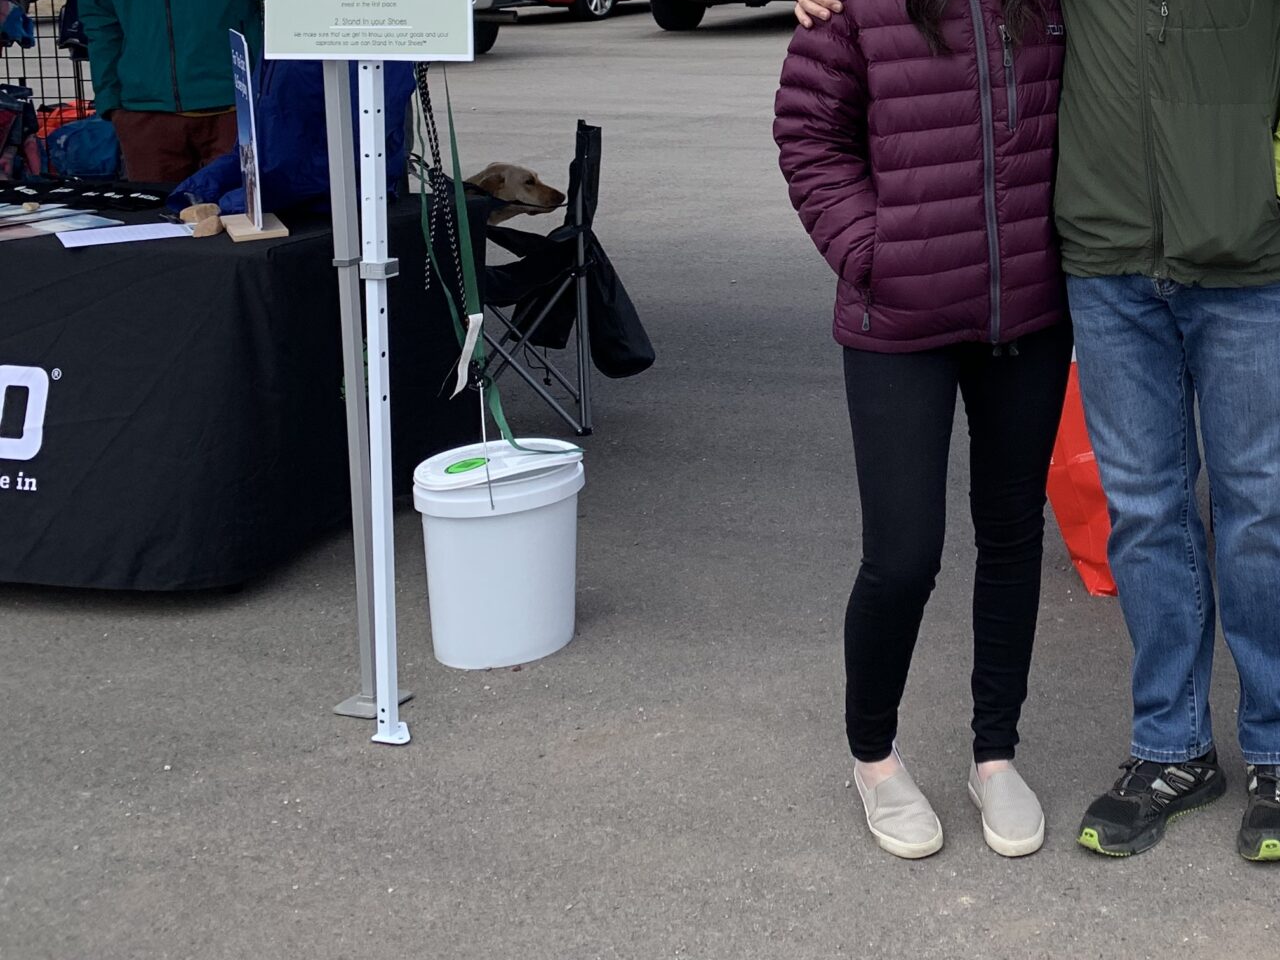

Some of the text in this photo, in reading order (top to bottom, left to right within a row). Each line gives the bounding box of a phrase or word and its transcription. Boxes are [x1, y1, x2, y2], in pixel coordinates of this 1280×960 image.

[342, 17, 360, 25] Stand
[362, 17, 369, 25] In
[371, 18, 386, 26] your
[387, 17, 407, 25] Shoes
[16, 472, 37, 491] in
